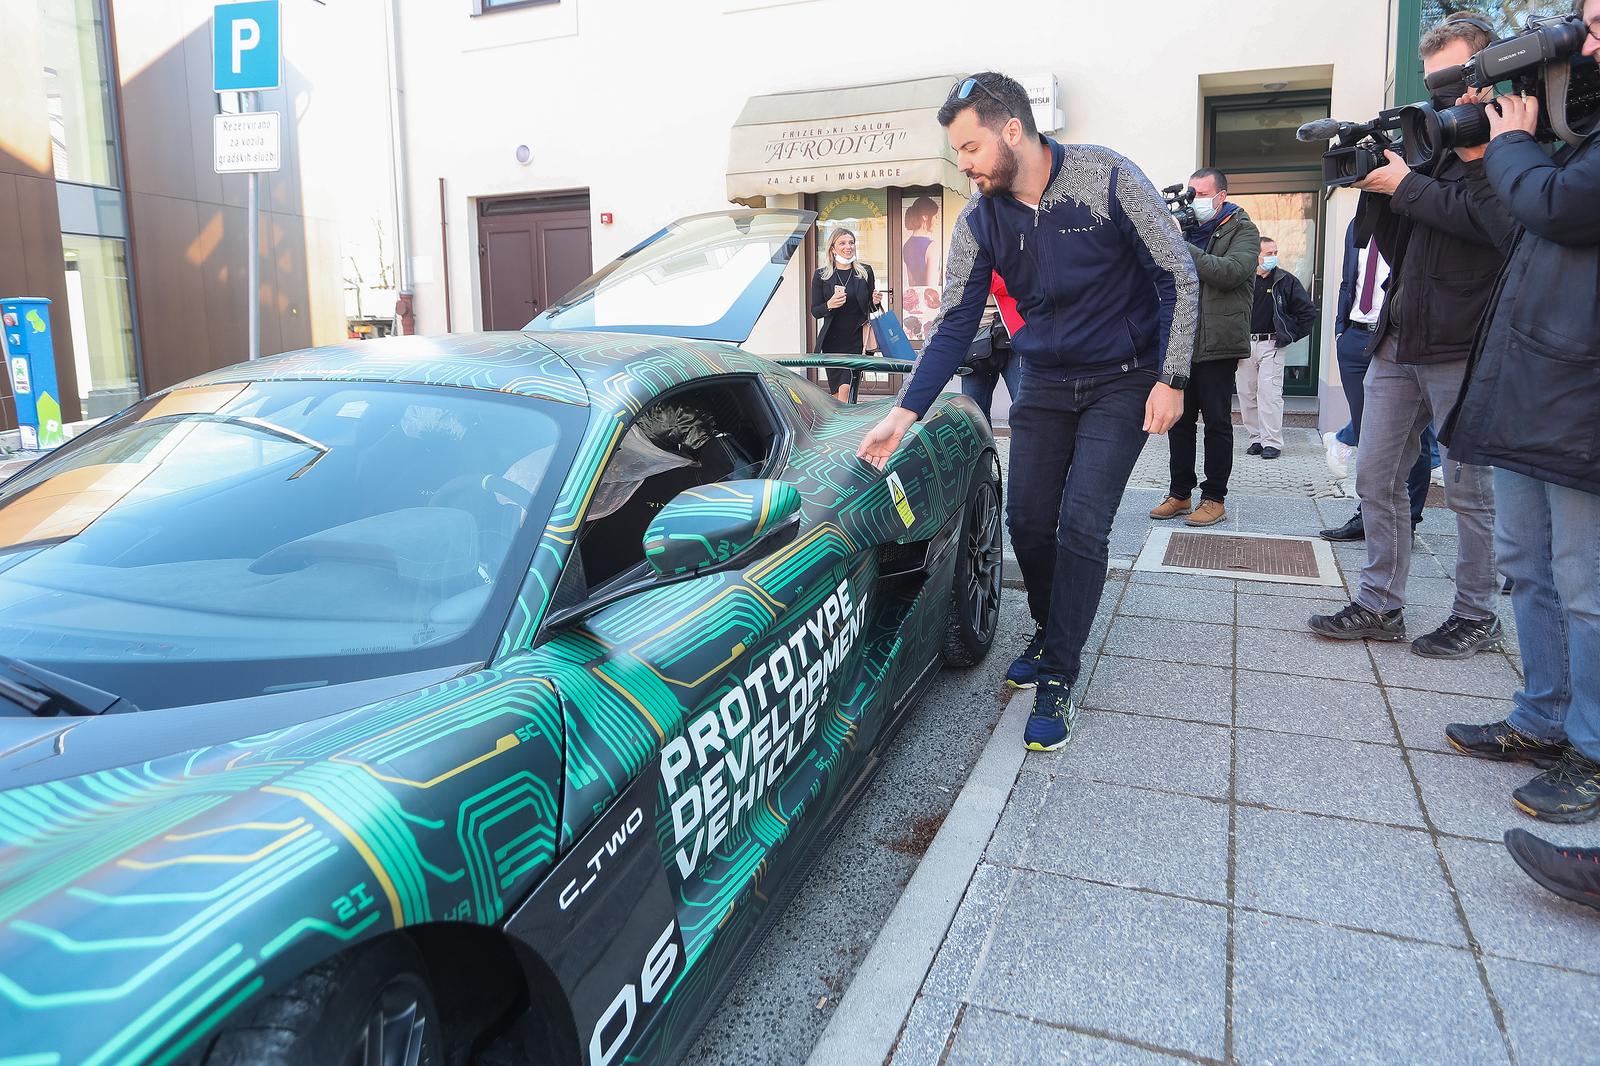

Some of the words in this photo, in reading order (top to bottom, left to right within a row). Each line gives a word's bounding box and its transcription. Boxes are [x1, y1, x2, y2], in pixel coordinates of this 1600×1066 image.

[231, 18, 260, 73] P
[767, 177, 779, 185] ZA
[789, 174, 815, 184] ŽENE
[825, 173, 828, 182] I
[838, 168, 902, 181] MUŠKARCE
[782, 127, 844, 139] FRIZERSKI
[854, 122, 891, 132] SALON
[660, 578, 850, 797] PROTOTYPE
[671, 592, 868, 844] DEVELOPMENT
[558, 807, 643, 910] C_TWO
[589, 918, 678, 1066] 06
